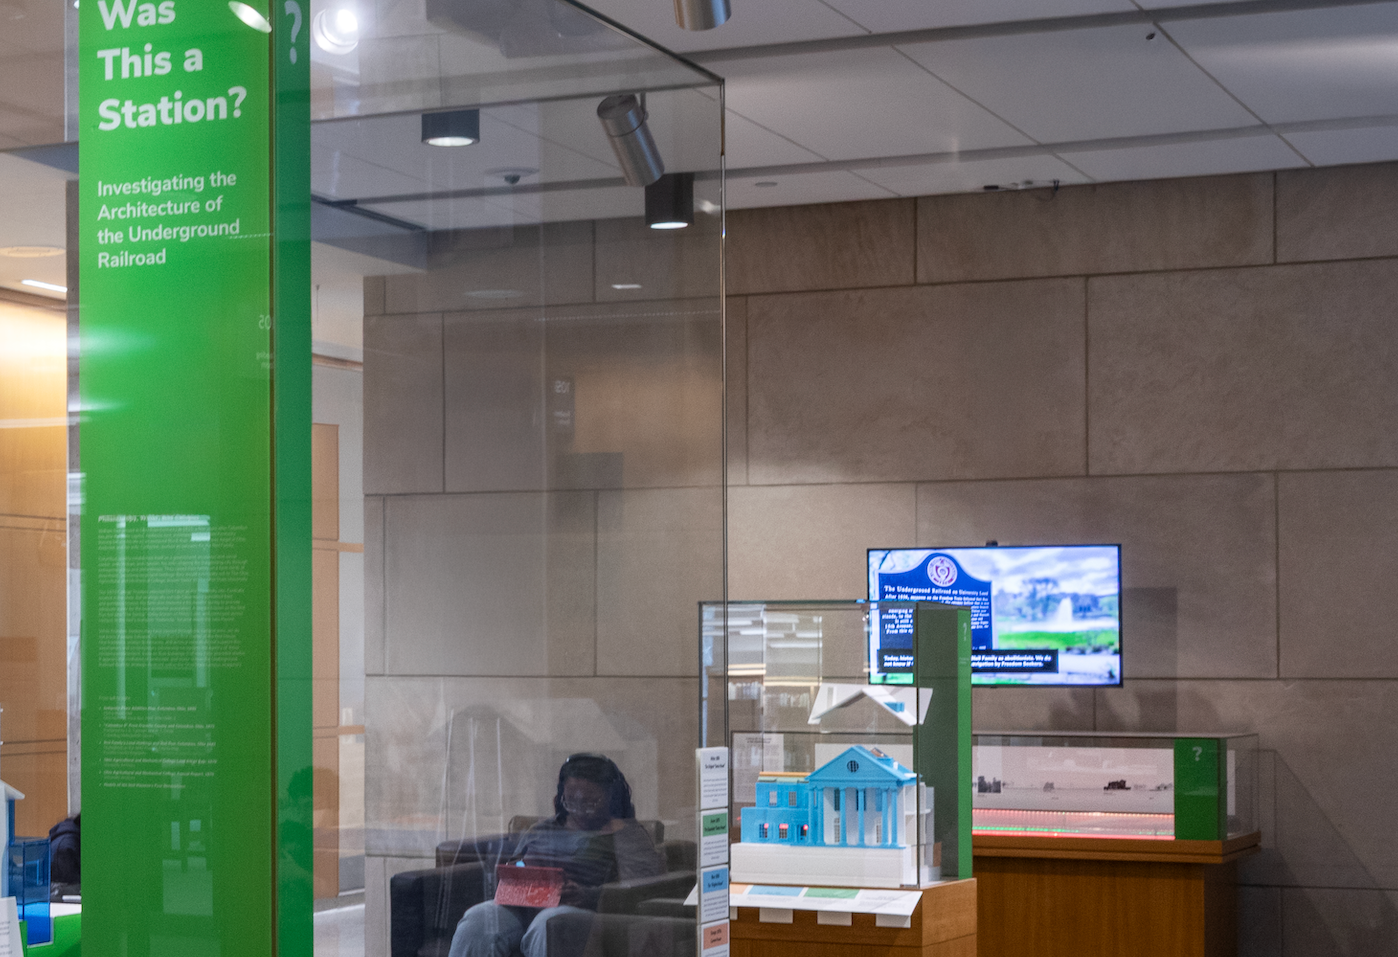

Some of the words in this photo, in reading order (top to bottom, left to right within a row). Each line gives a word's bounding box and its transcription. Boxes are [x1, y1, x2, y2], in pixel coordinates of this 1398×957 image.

[98, 0, 176, 30] Was
[97, 43, 172, 80] This
[184, 48, 203, 72] a
[98, 86, 247, 130] Station?
[98, 174, 204, 196] Investigating
[210, 171, 236, 187] the
[97, 200, 200, 221] Architecture
[205, 196, 223, 211] of
[97, 225, 123, 244] the
[129, 218, 240, 242] Underground
[98, 248, 166, 268] Railroad
[1192, 746, 1202, 761] ?
